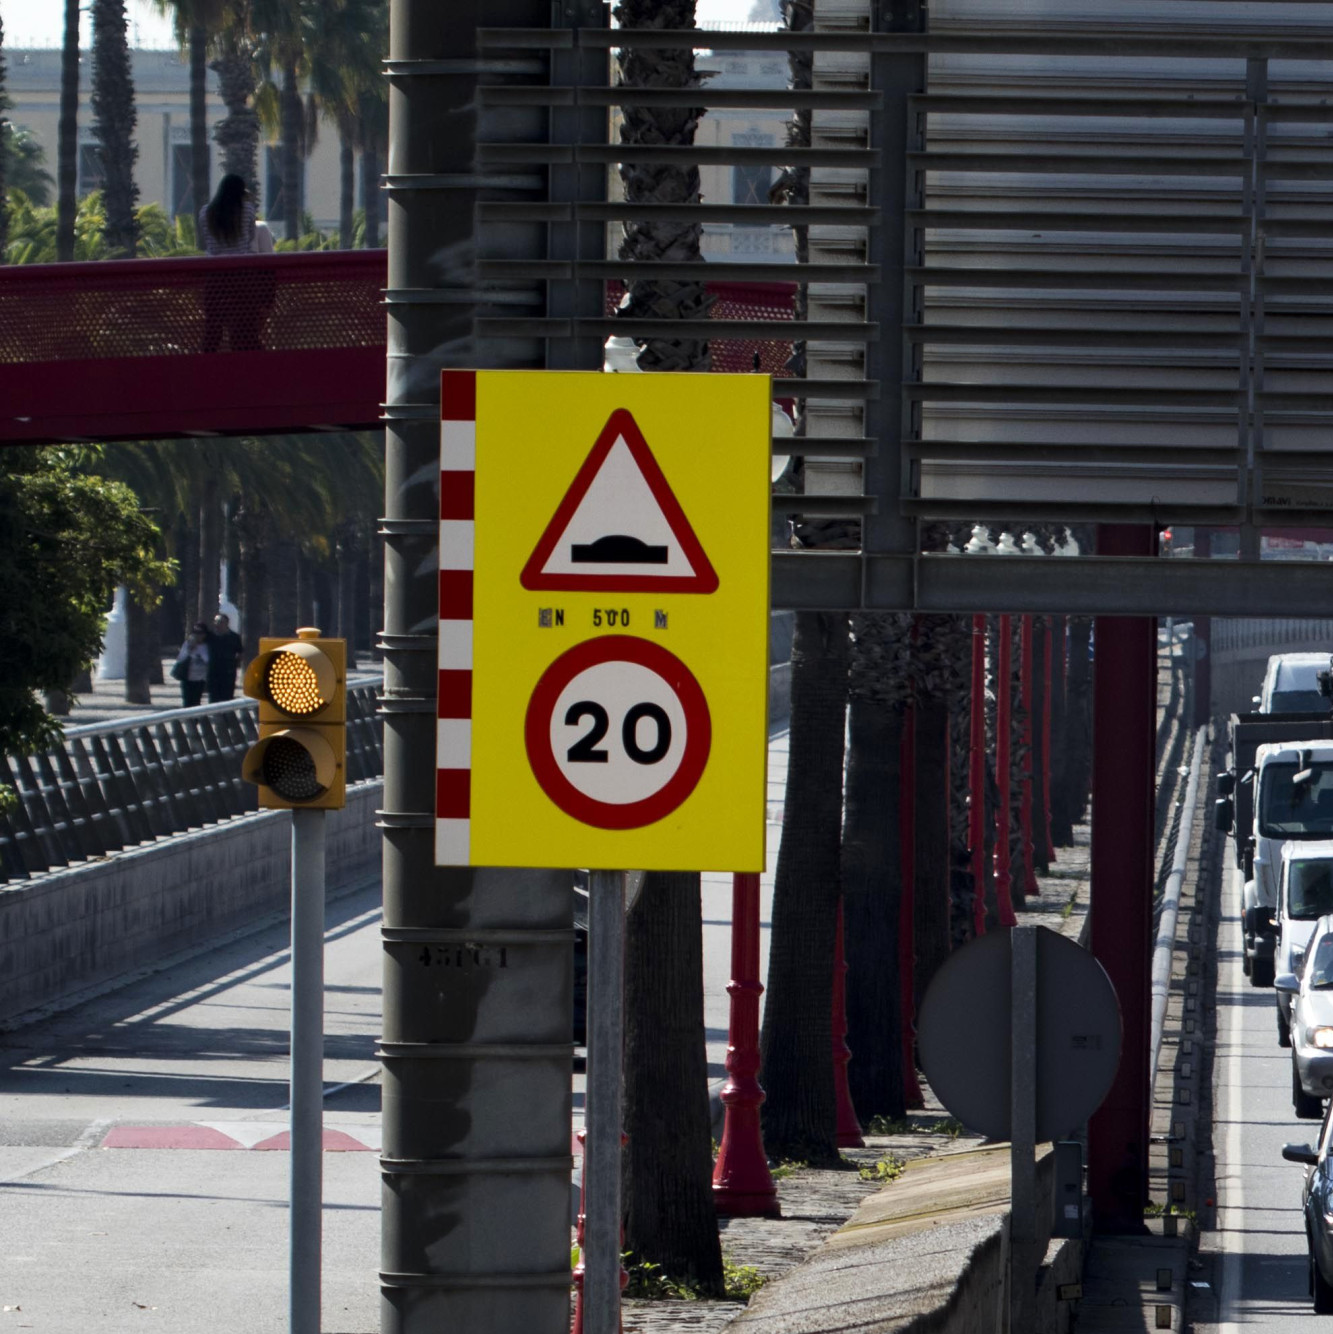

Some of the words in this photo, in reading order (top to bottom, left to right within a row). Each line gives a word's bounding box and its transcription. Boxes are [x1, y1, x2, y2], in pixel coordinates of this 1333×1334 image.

[540, 608, 565, 627] EN
[593, 607, 630, 627] 500
[655, 609, 668, 629] M
[564, 700, 672, 765] 20
